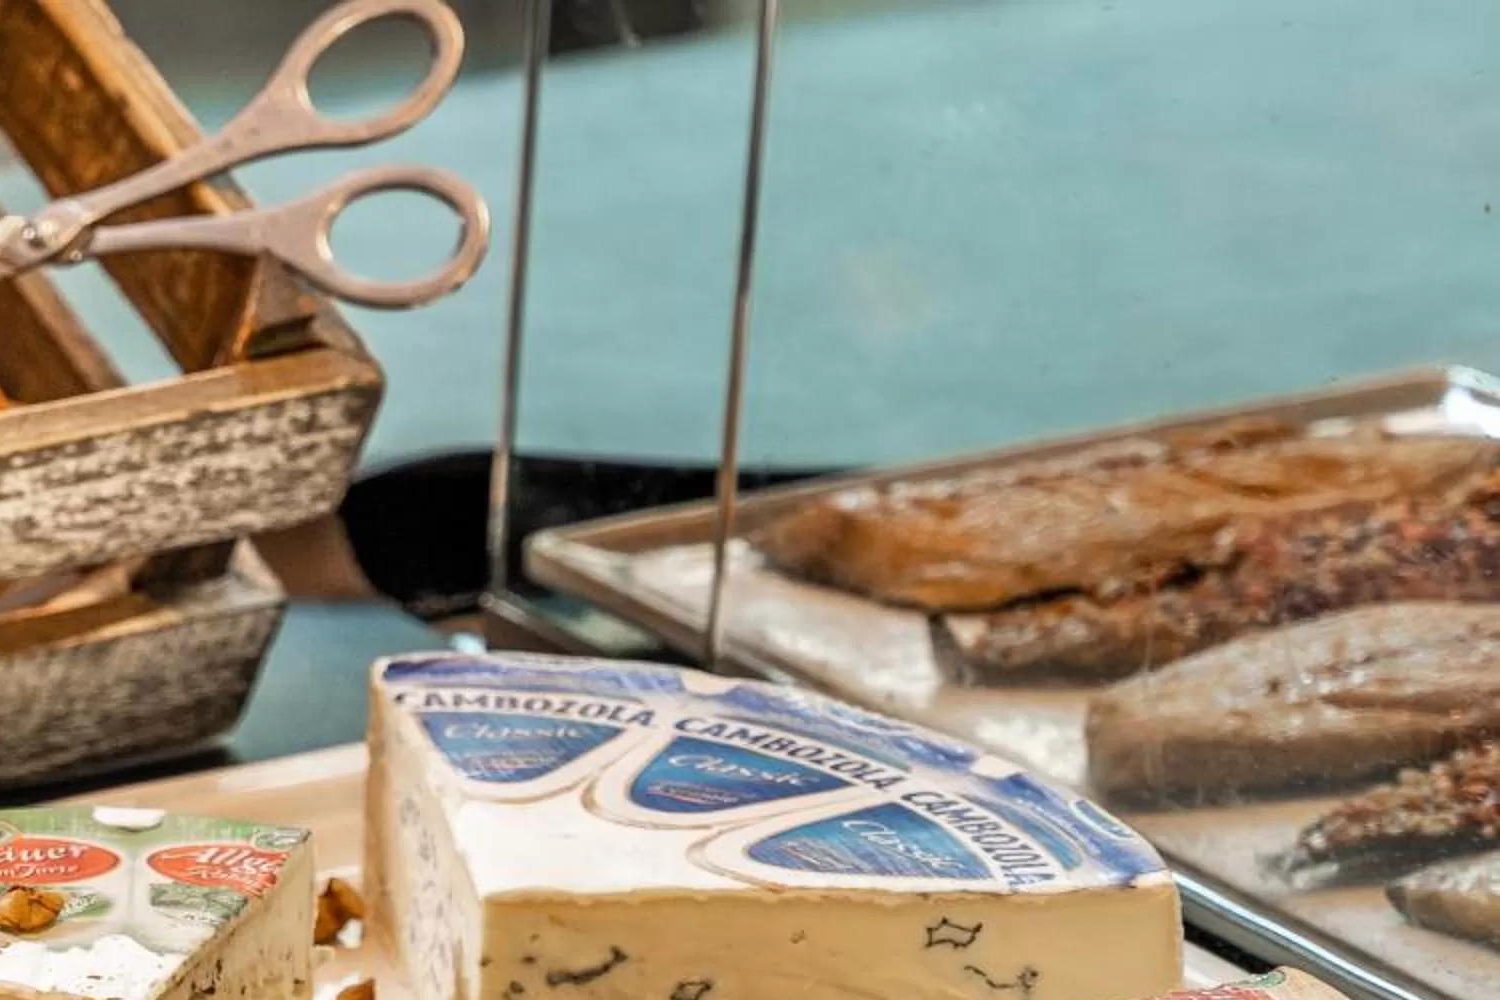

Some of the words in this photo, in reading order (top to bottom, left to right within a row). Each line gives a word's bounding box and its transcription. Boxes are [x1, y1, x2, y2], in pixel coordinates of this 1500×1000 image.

[394, 691, 657, 727] CAMBOZOLA
[674, 716, 907, 792] CAMBOZOLA
[901, 790, 1057, 887] CAMBOZOLA
